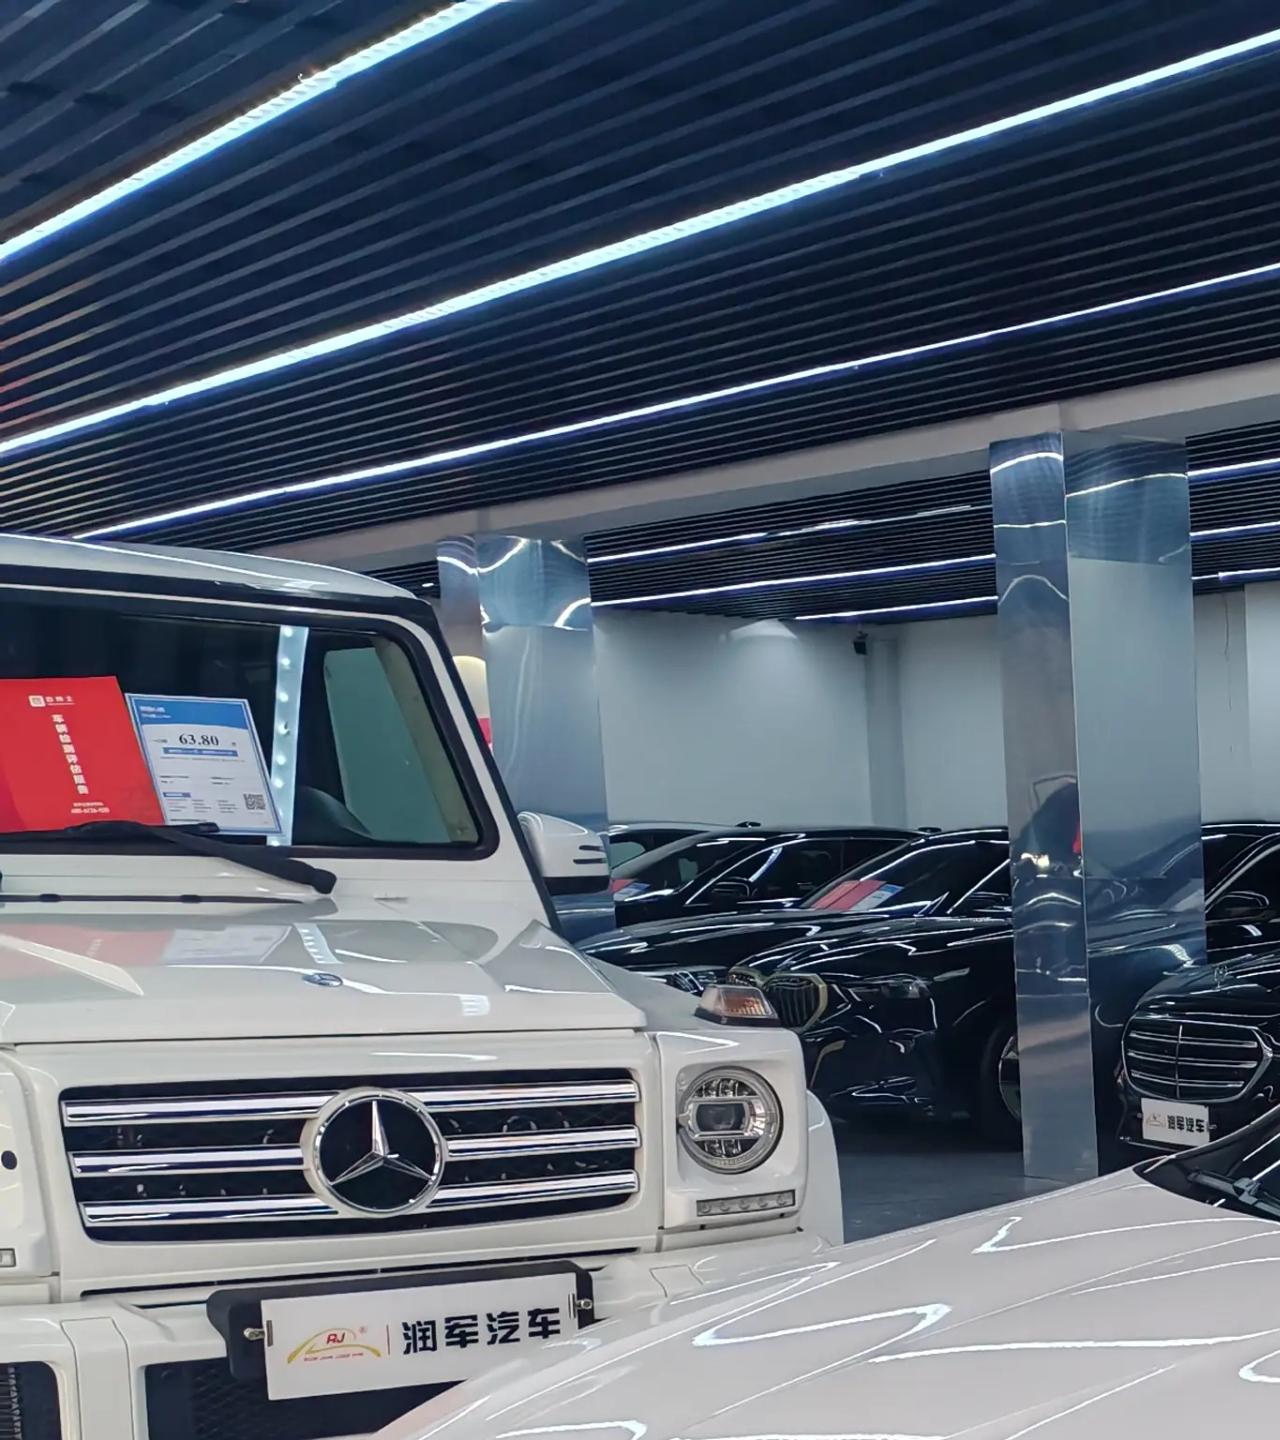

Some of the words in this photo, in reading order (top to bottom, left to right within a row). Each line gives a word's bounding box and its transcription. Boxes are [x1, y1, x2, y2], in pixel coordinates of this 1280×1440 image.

[178, 732, 219, 746] 63.80
[402, 1307, 561, 1354] 润军汽车
